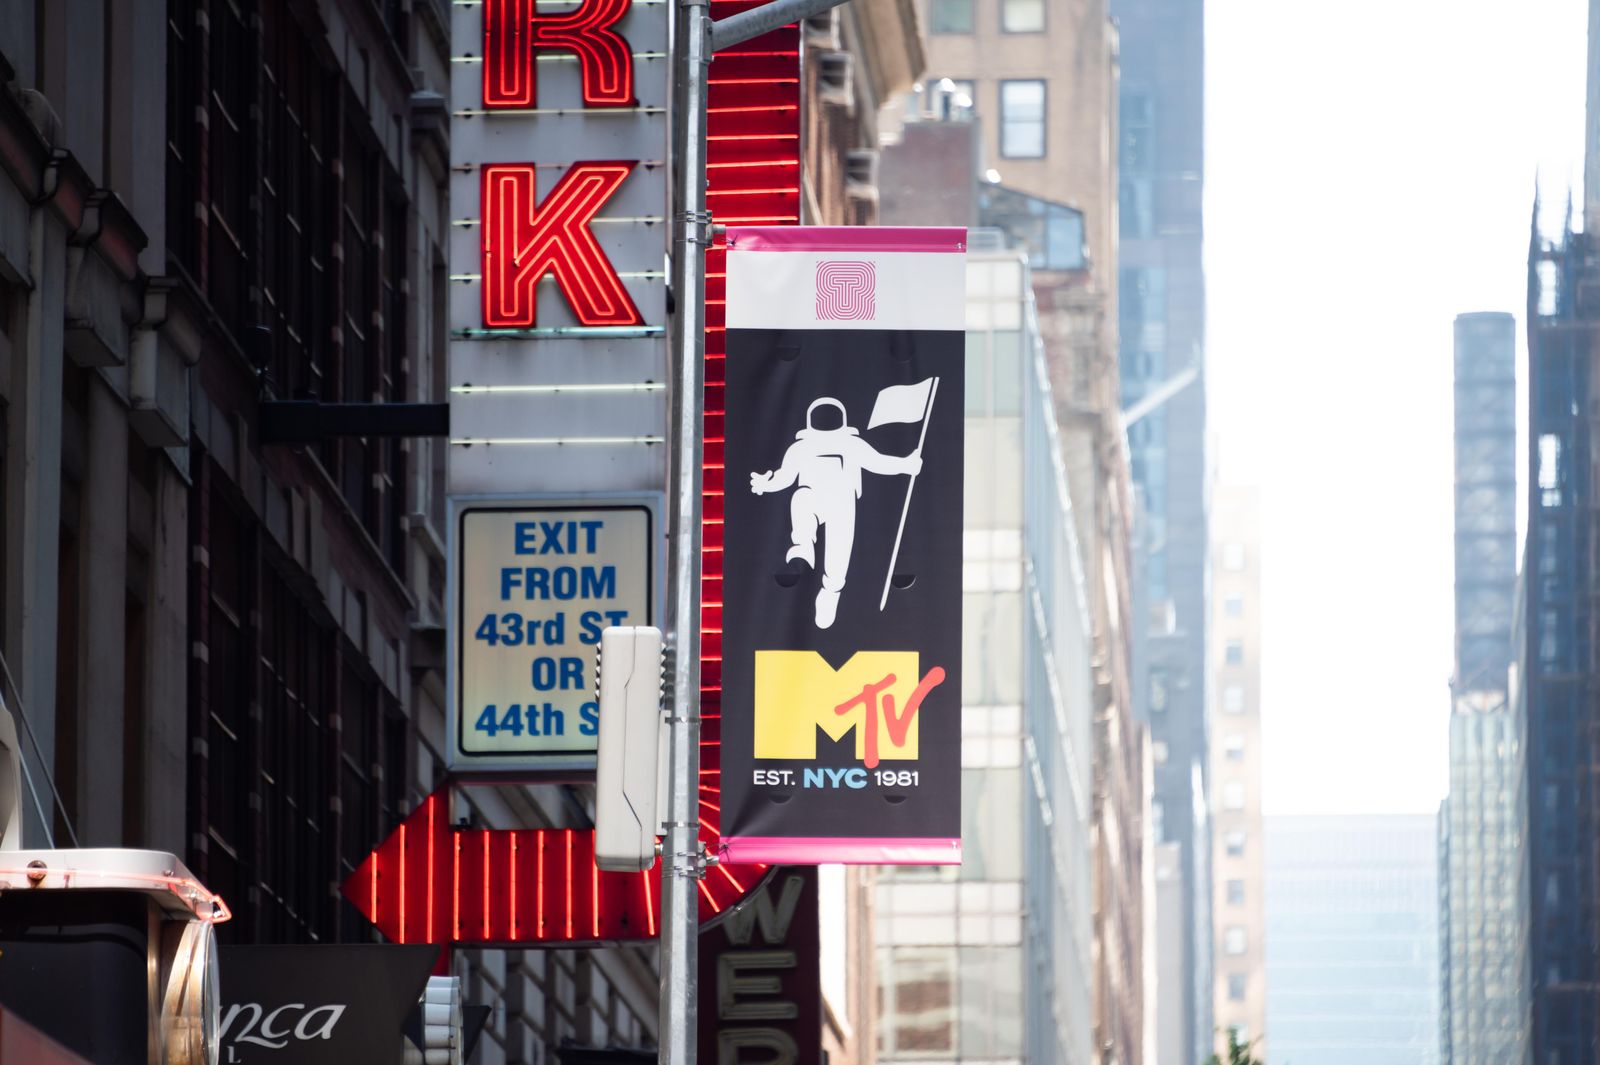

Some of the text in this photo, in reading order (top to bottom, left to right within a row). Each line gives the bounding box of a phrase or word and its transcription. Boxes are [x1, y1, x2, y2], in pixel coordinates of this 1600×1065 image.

[514, 521, 603, 555] EXIT
[501, 566, 616, 600] FROM
[475, 612, 565, 646] 43rd
[531, 657, 585, 691] OR
[475, 702, 598, 737] 44th S
[754, 650, 946, 768] MTV
[753, 767, 919, 789] EST. NYC 1981
[219, 1003, 347, 1049] nca
